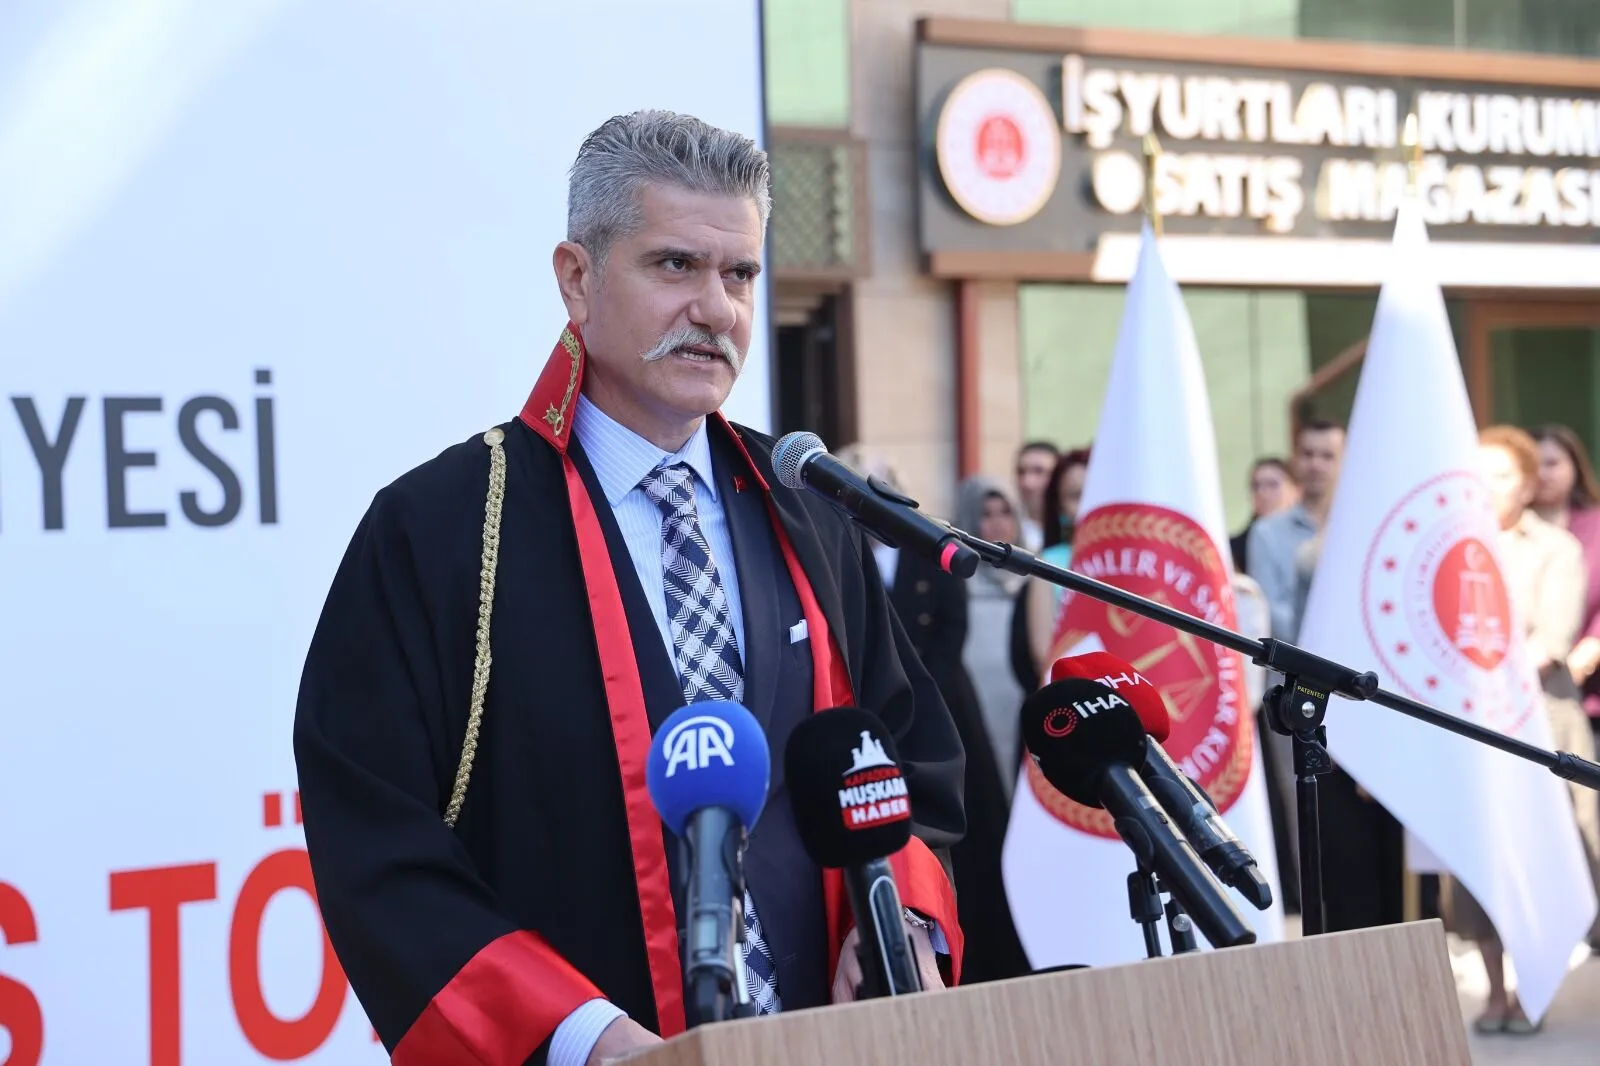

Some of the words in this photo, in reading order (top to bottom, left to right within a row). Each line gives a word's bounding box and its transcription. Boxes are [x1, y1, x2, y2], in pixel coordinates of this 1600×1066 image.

[1416, 90, 1600, 157] KURUM
[1154, 151, 1304, 233] SATIŞ
[0, 368, 279, 532] YESİ
[1072, 693, 1130, 719] İHA
[1297, 685, 1326, 700] PATENTED
[664, 717, 735, 778] AA
[851, 798, 909, 825] HABER
[108, 791, 382, 1066] TÖ
